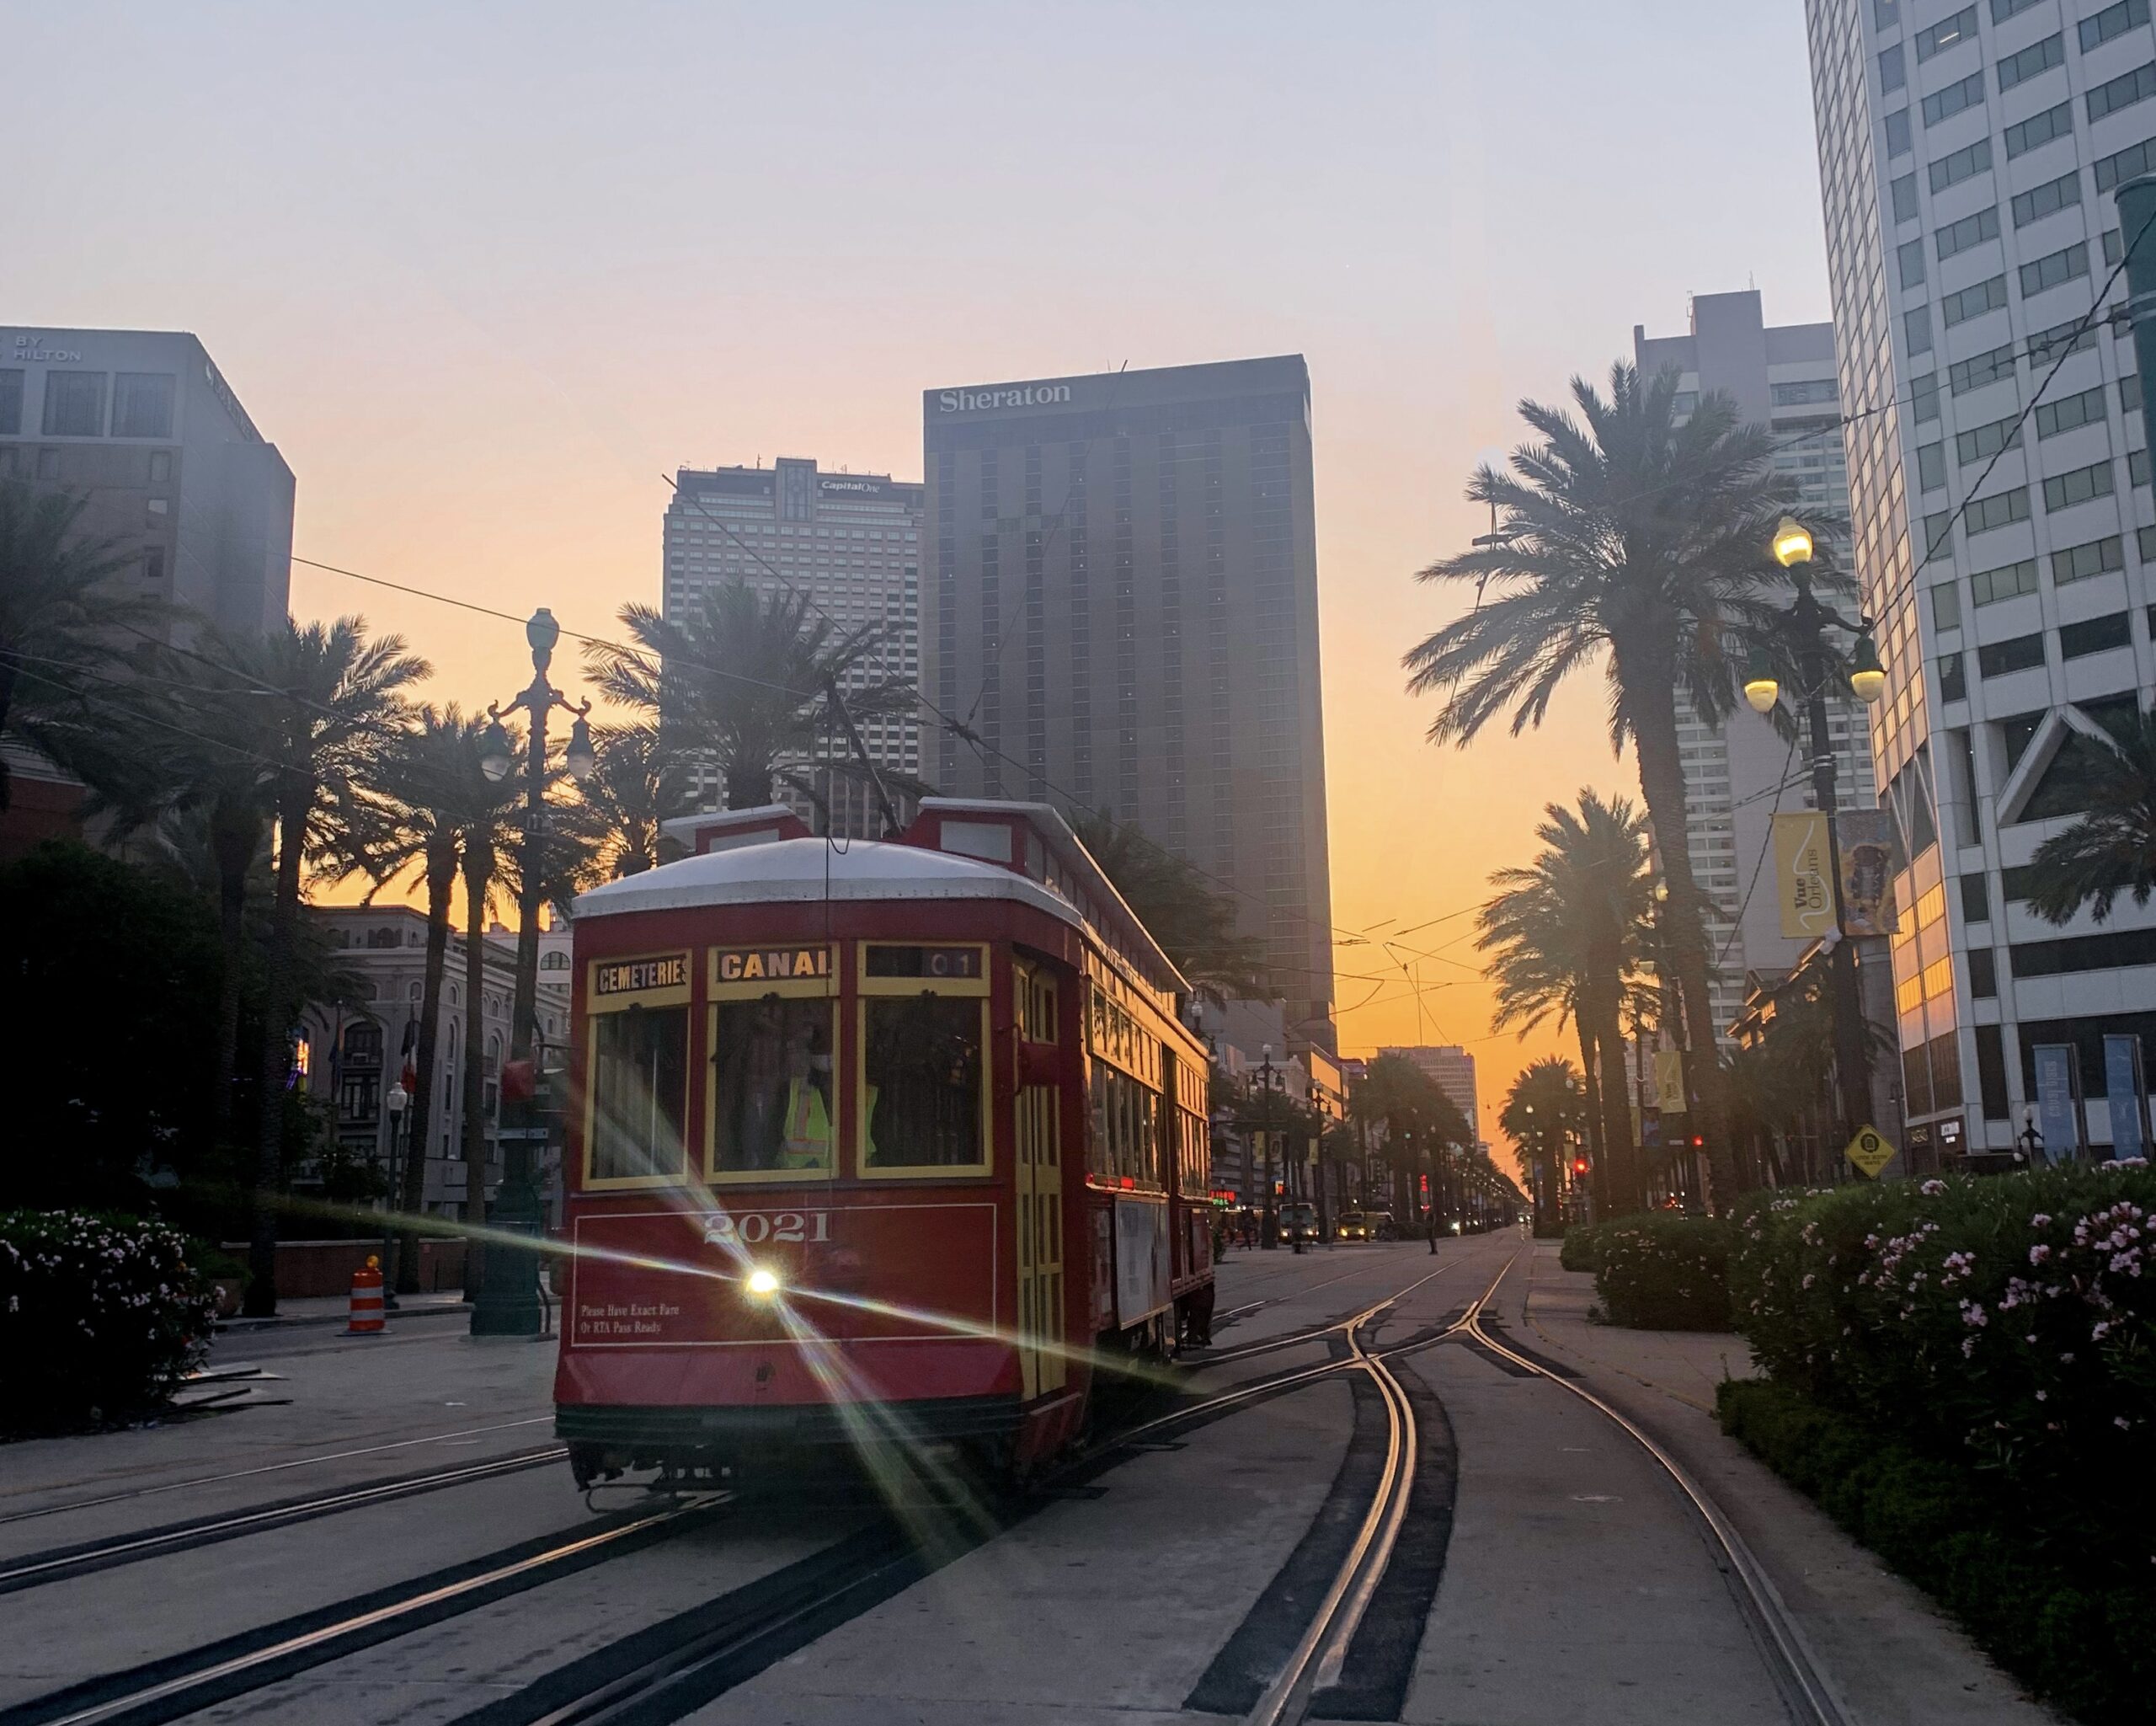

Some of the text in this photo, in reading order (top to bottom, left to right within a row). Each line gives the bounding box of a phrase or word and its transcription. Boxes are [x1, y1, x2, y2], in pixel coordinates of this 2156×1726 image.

[16, 336, 44, 348] BY
[14, 350, 82, 362] HILTON
[940, 385, 1071, 413] Sheraton
[1808, 848, 1822, 910] Orleans
[1794, 878, 1807, 910] Vue
[704, 1212, 831, 1244] 2021
[581, 1302, 680, 1316] Please Have Exact Fare
[581, 1321, 662, 1334] Or RTA Pass Ready
